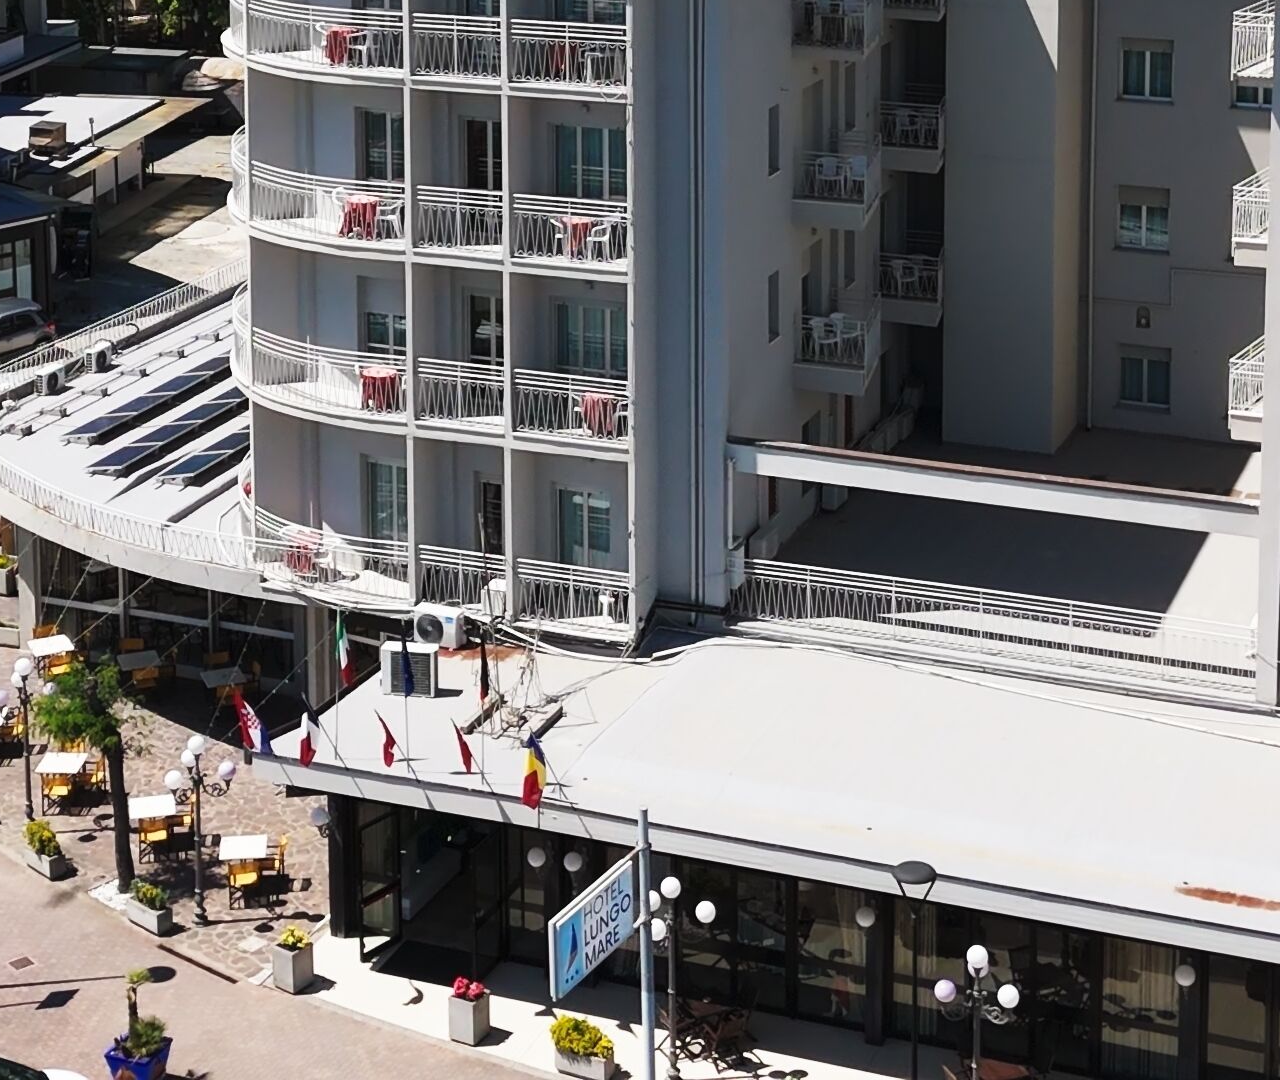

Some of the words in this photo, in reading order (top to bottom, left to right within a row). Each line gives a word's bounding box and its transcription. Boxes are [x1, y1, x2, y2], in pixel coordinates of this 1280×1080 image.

[584, 878, 624, 924] HOTEL
[584, 893, 631, 947] LUNGO
[585, 924, 620, 970] MARE
